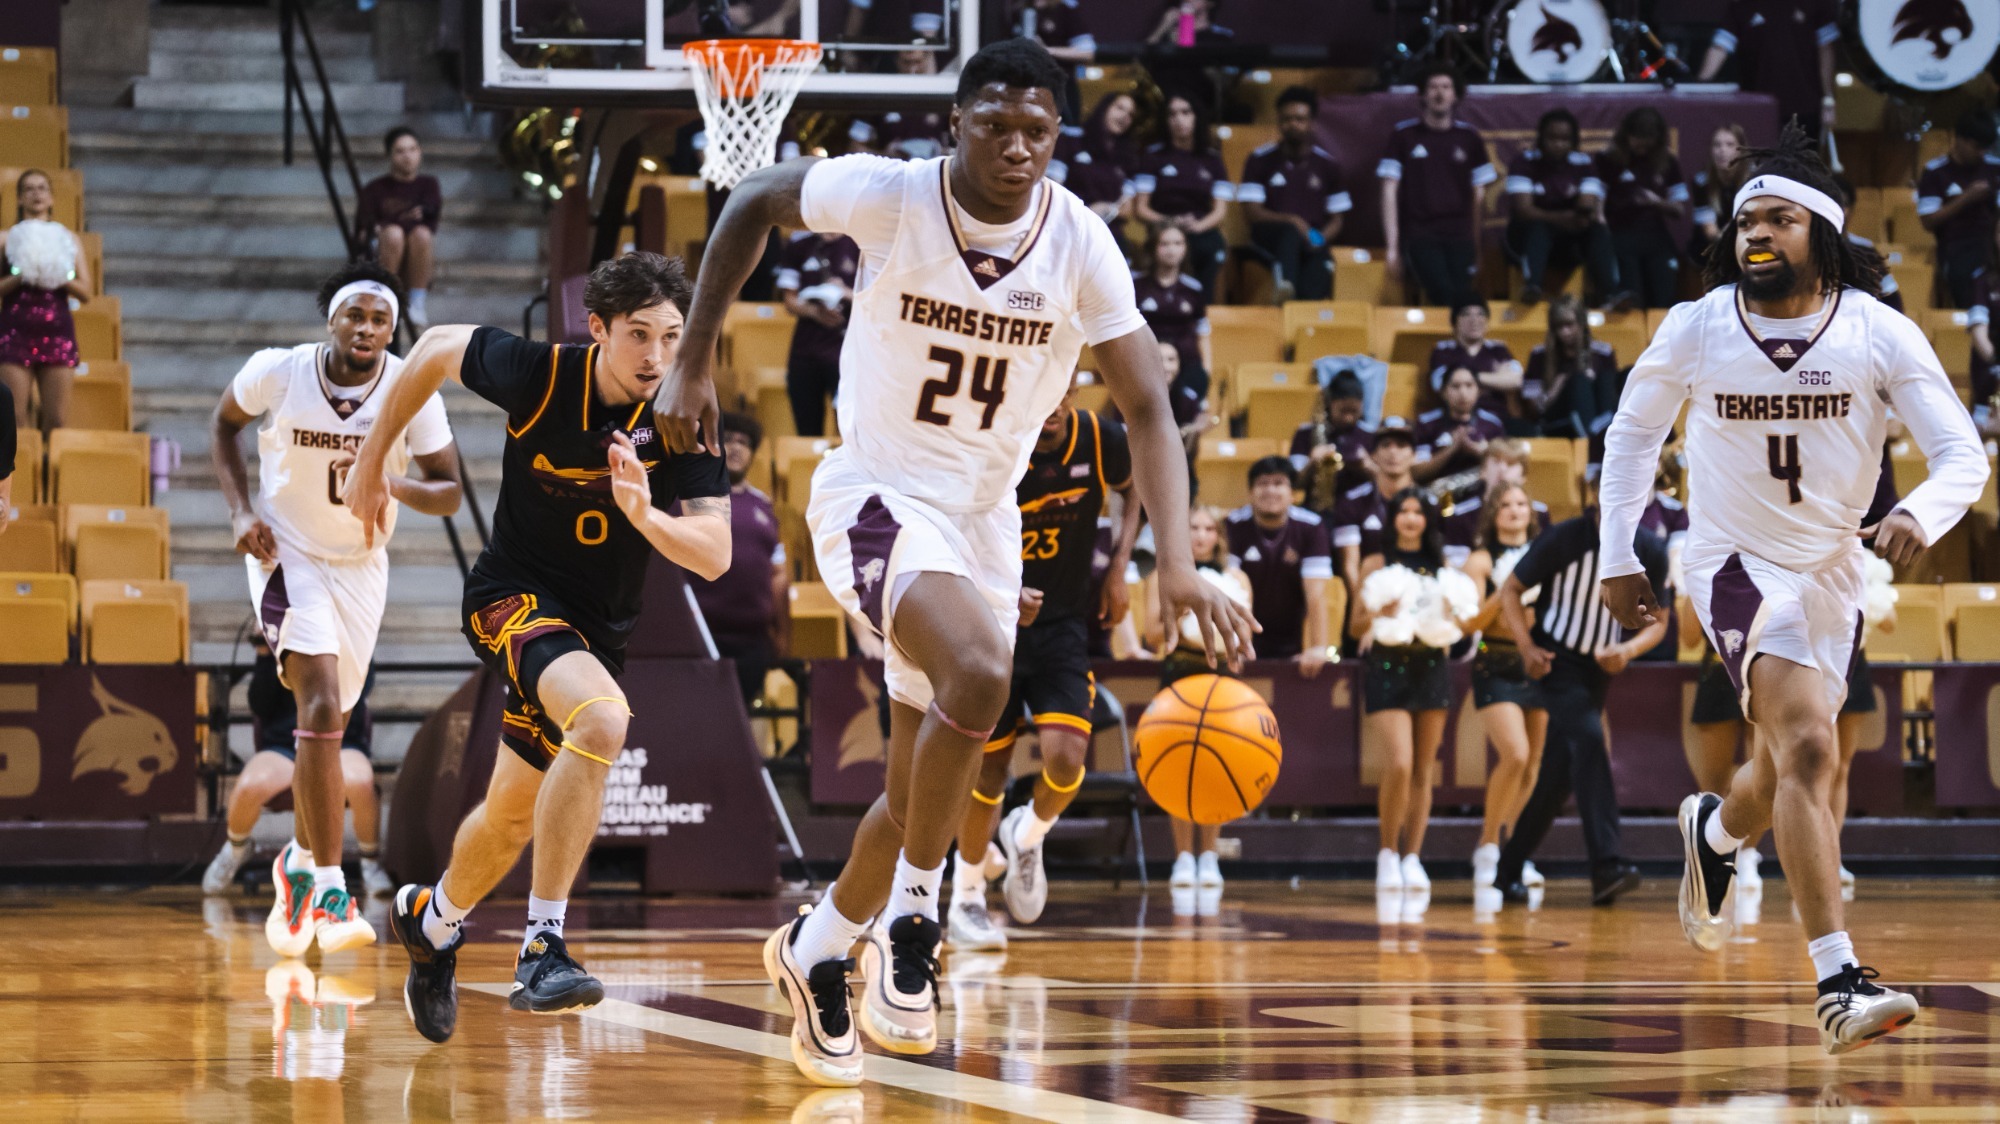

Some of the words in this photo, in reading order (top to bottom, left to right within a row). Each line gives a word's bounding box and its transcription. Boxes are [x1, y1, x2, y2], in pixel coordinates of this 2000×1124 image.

[1007, 290, 1046, 312] SBC
[900, 292, 978, 337] TEXAS
[978, 311, 1055, 346] STATE
[915, 344, 1009, 431] 24
[1799, 370, 1832, 386] SBC
[1714, 393, 1785, 421] TEXAS
[1785, 392, 1853, 420] STATE
[292, 428, 341, 450] TEXAS
[1766, 433, 1803, 504] 4
[576, 510, 608, 545] 0
[1021, 528, 1060, 560] 23
